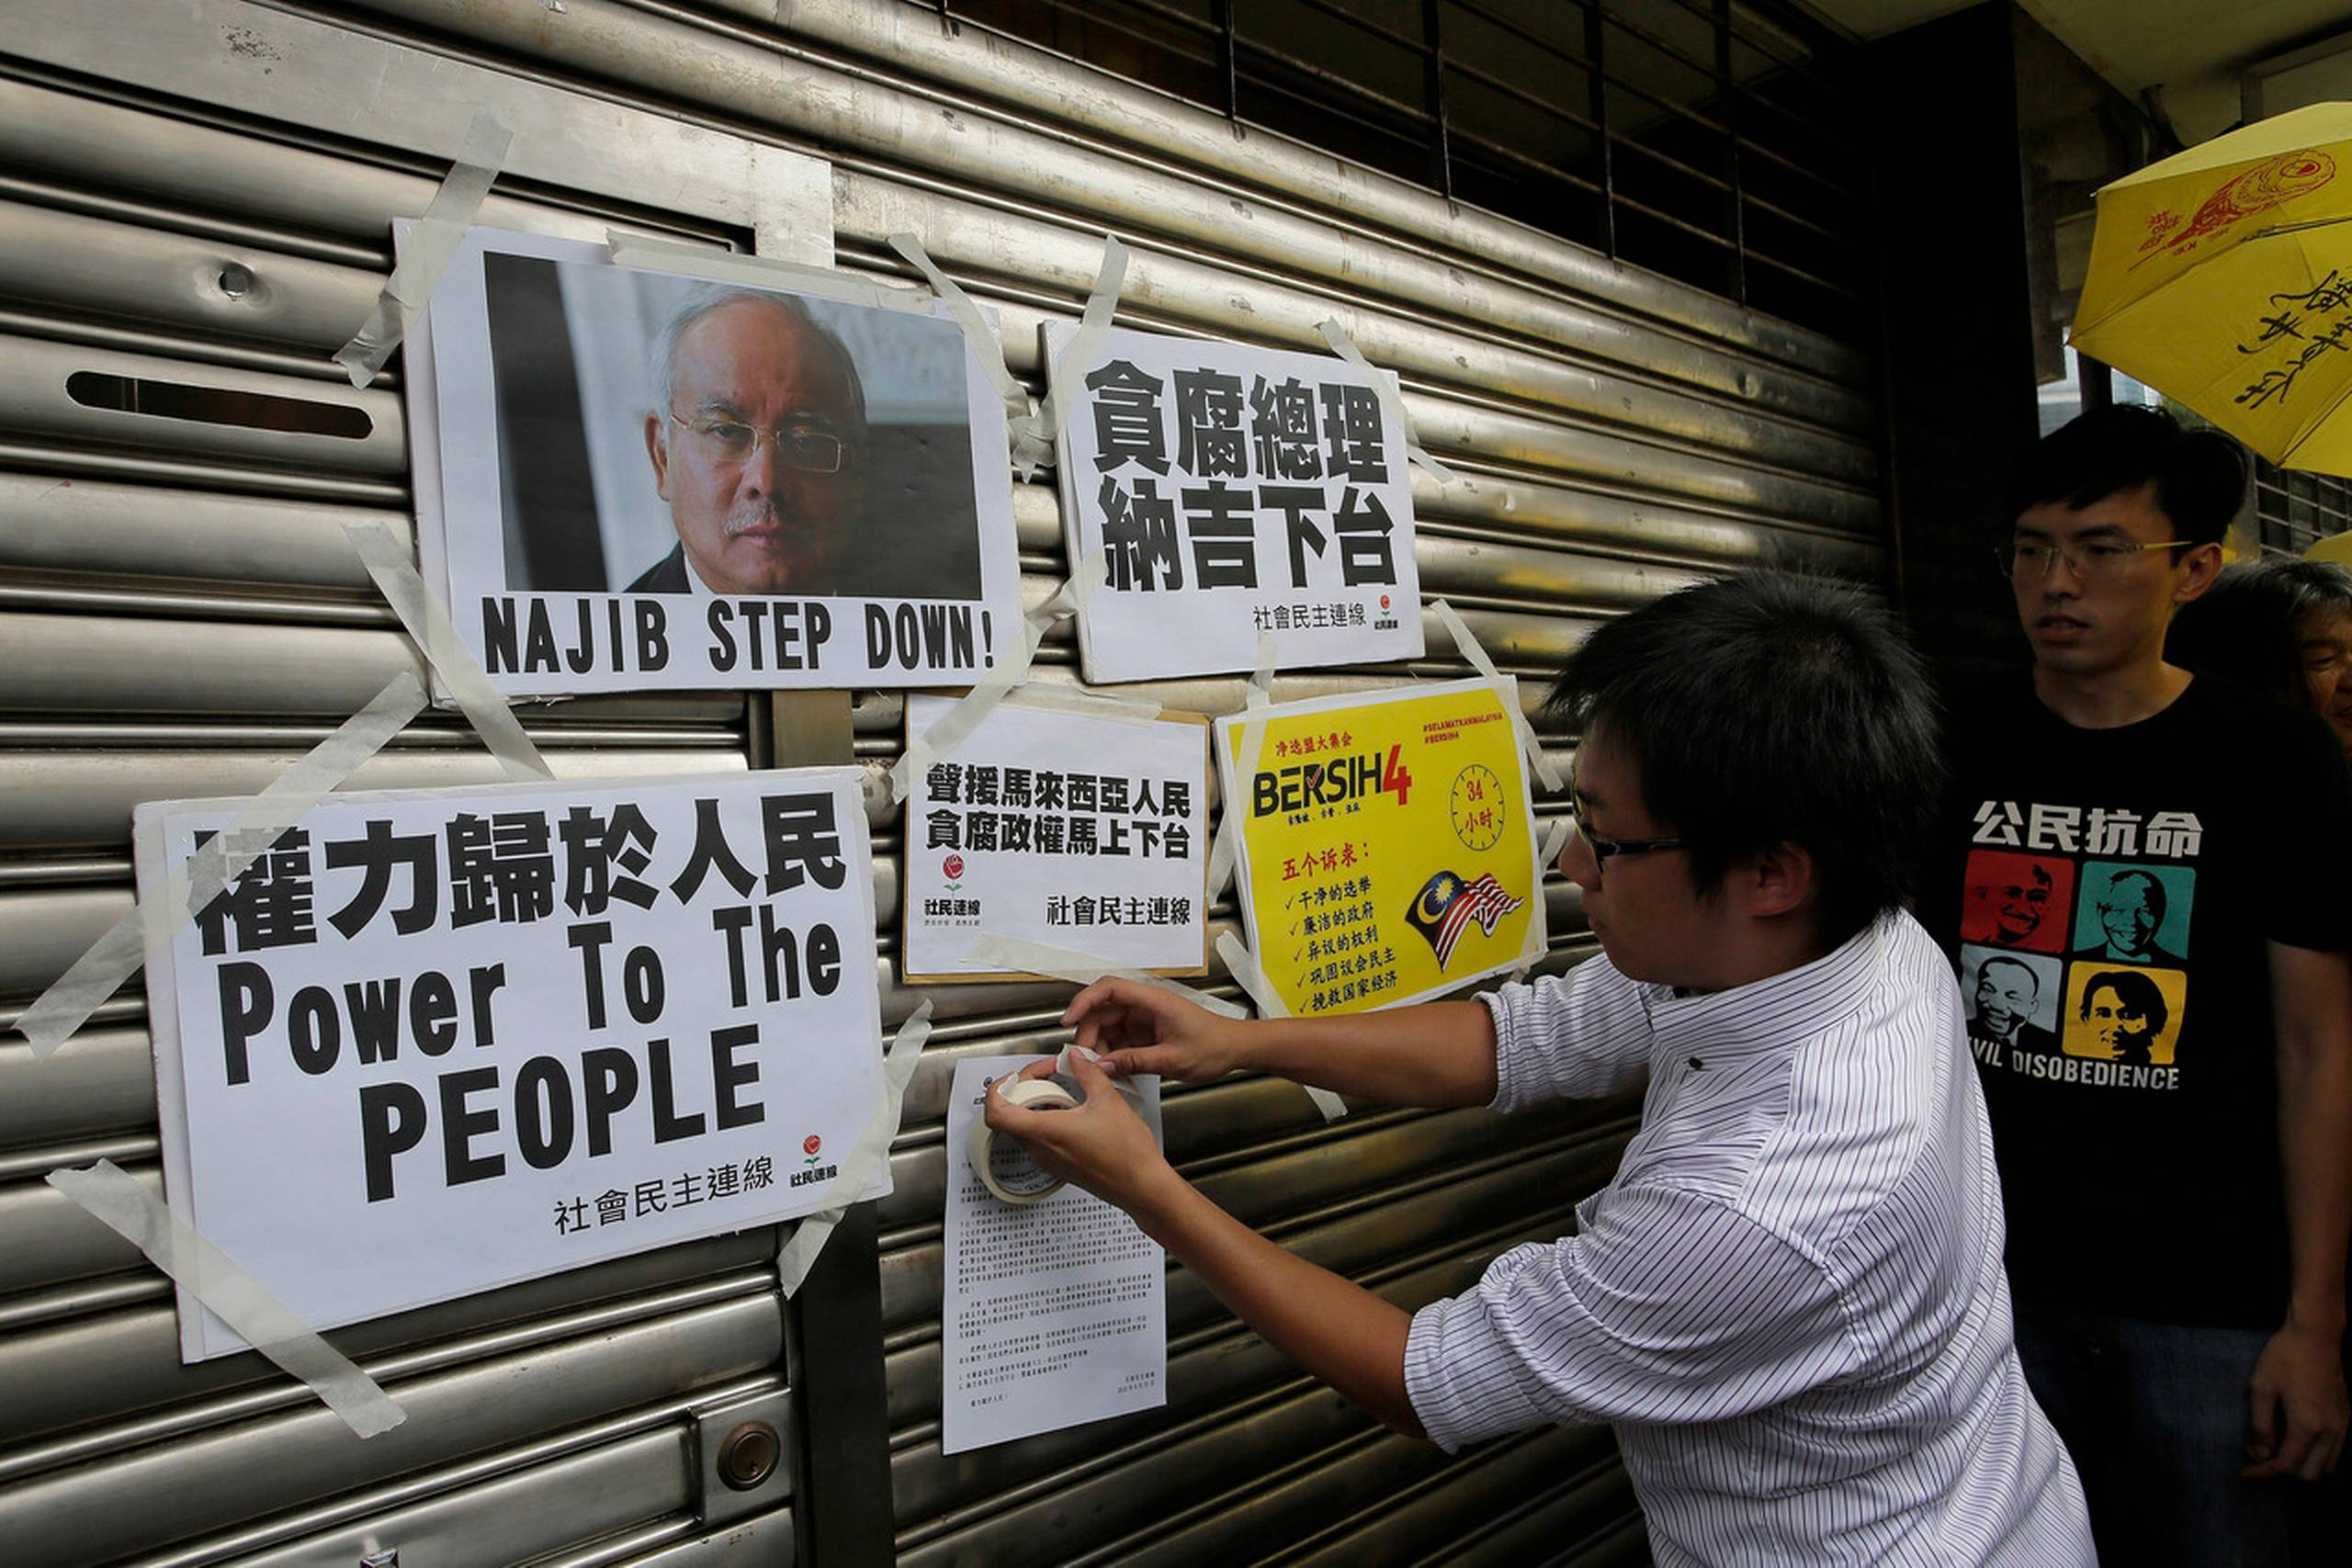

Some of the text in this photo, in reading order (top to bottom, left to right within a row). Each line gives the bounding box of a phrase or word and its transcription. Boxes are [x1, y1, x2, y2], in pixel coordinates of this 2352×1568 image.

[1084, 359, 1389, 484] 貪腐總理
[1097, 474, 1397, 592] 納吉下台
[481, 597, 994, 673] NAJIB STEP DOWN!
[1253, 602, 1367, 630] 社會民主連線
[926, 763, 1191, 819] 聲援馬來西亞人民
[1467, 780, 1483, 802] 34
[926, 809, 1191, 860] 貪腐政權馬上下台
[1464, 810, 1493, 834] 小时
[1973, 800, 2203, 858] 公民抗命
[187, 792, 847, 956] 權力歸於人民
[1298, 876, 1372, 909] 干净的选举
[924, 899, 980, 917] 社民連線
[1046, 896, 1191, 926] 社會民主連線
[1303, 903, 1374, 935] 廉洁的政府
[1306, 926, 1378, 963] 异议的权利
[1309, 947, 1396, 987] 巩固议会民主
[217, 904, 842, 1086] Power To The
[1312, 970, 1398, 1011] 挽救国家经济
[1968, 1035, 2180, 1090] VIL DISOBEDIENCE
[358, 1022, 765, 1203] PEOPLE
[554, 1156, 775, 1236] 社會民主連線
